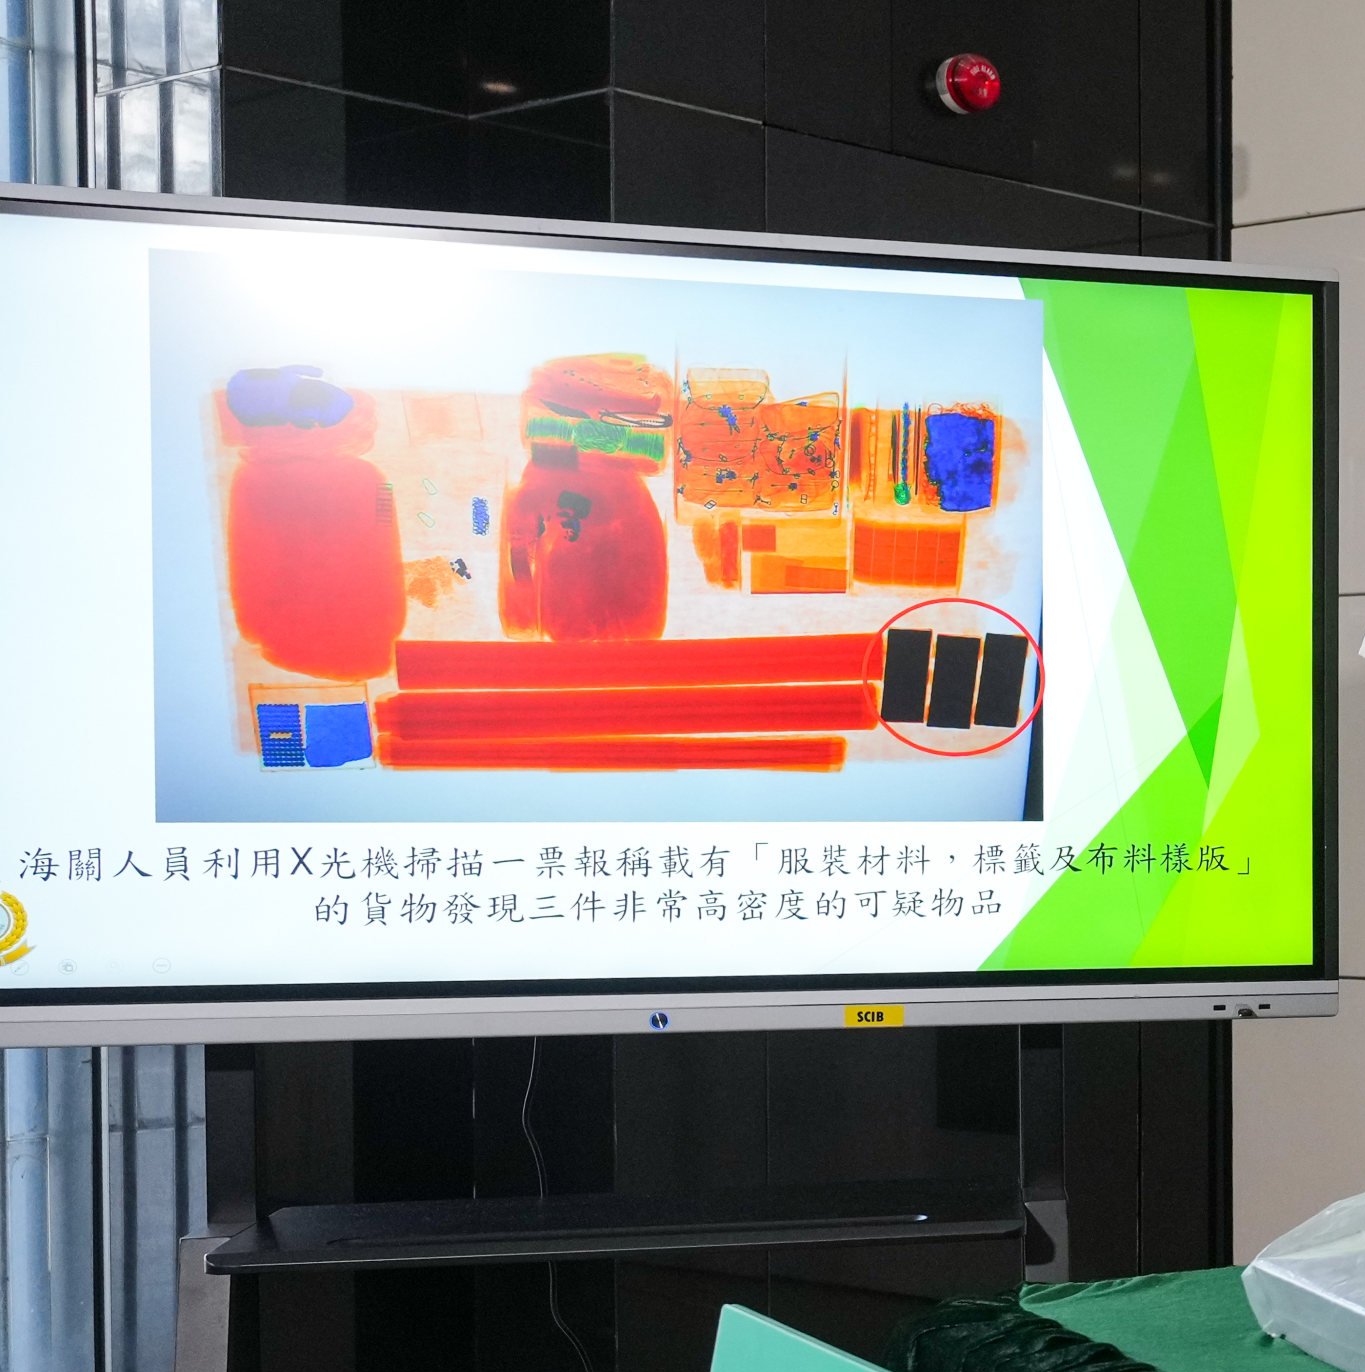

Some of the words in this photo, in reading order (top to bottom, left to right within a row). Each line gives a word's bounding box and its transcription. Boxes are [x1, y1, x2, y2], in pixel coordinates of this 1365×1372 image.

[315, 887, 1003, 927] 的貨物發現三件非常高密度的可疑物品
[857, 1011, 885, 1023] SCIB
